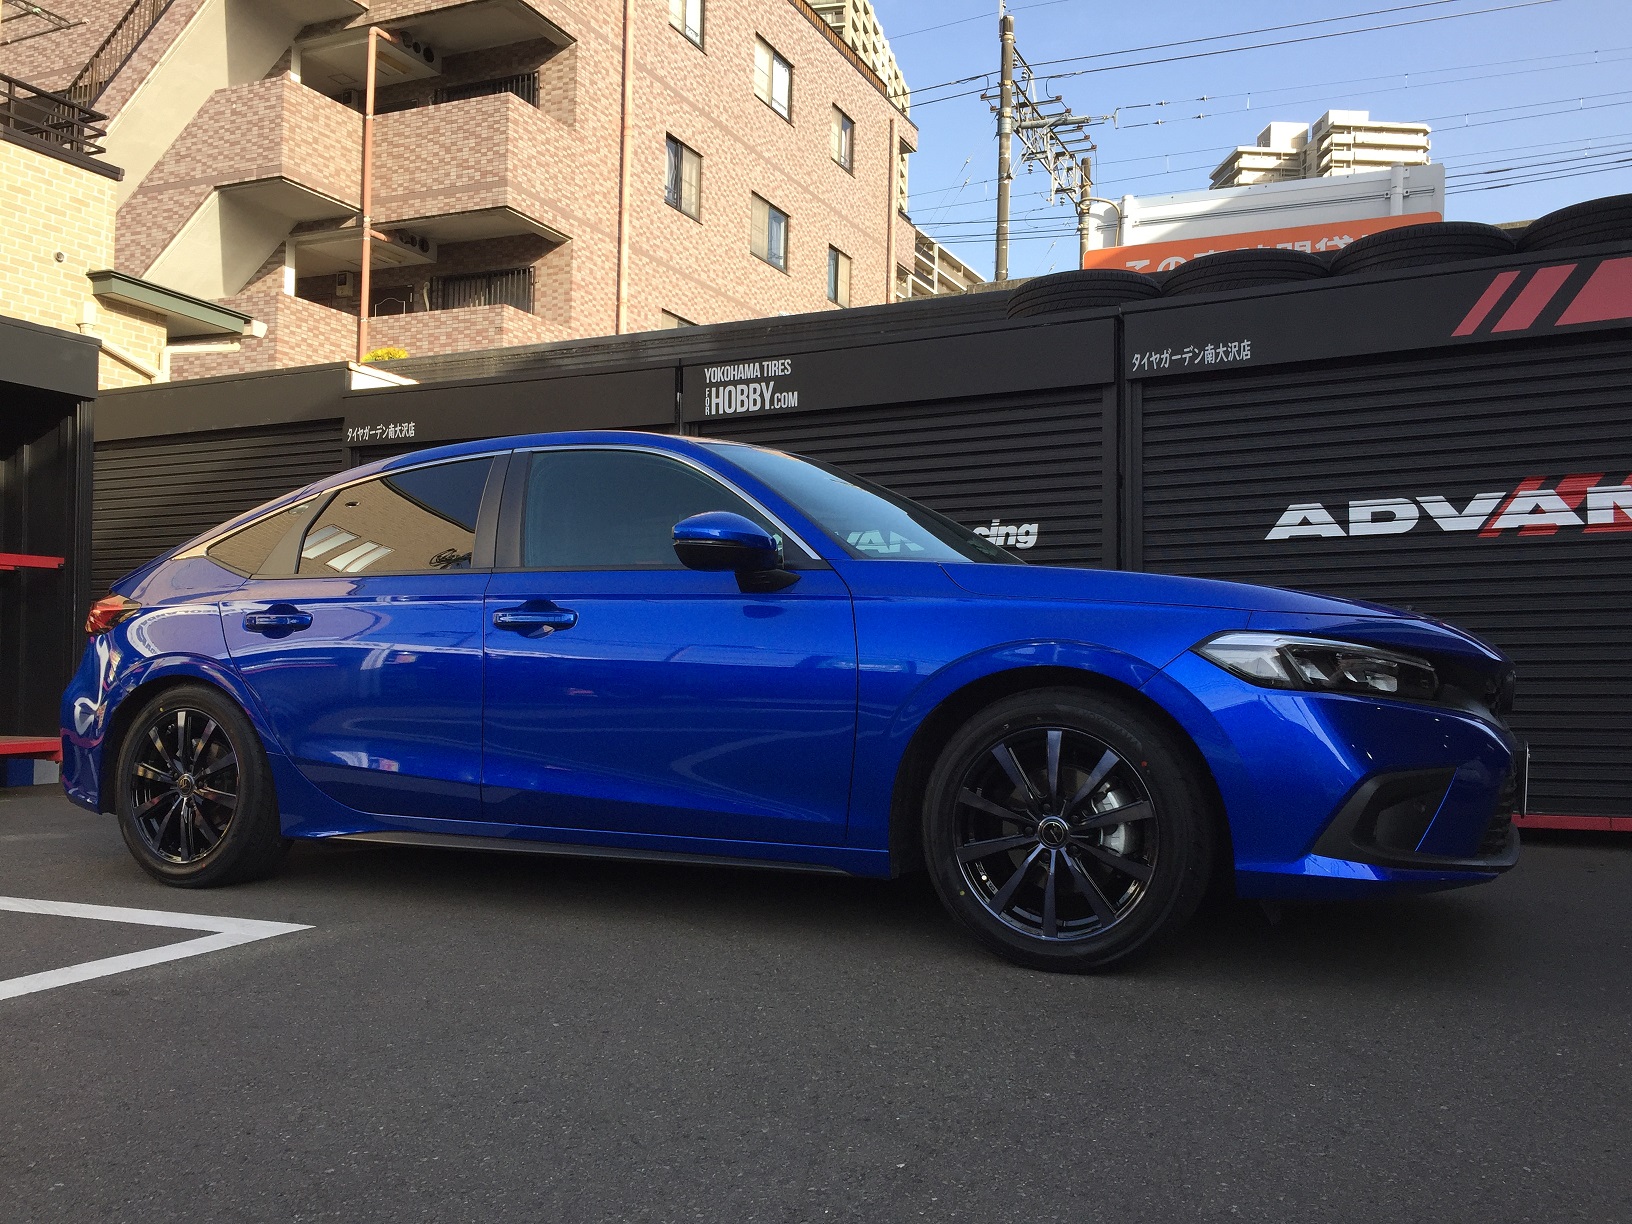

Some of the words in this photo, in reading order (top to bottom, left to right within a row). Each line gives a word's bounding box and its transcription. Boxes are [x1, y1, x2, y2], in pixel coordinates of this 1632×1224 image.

[1132, 339, 1251, 372] タイヤガーデン南大沢店
[704, 362, 761, 383] YOKOHAMA
[762, 359, 792, 377] TIRES
[711, 381, 798, 415] HOBBY.COM
[347, 421, 416, 442] タイヤガーデン南大沢店
